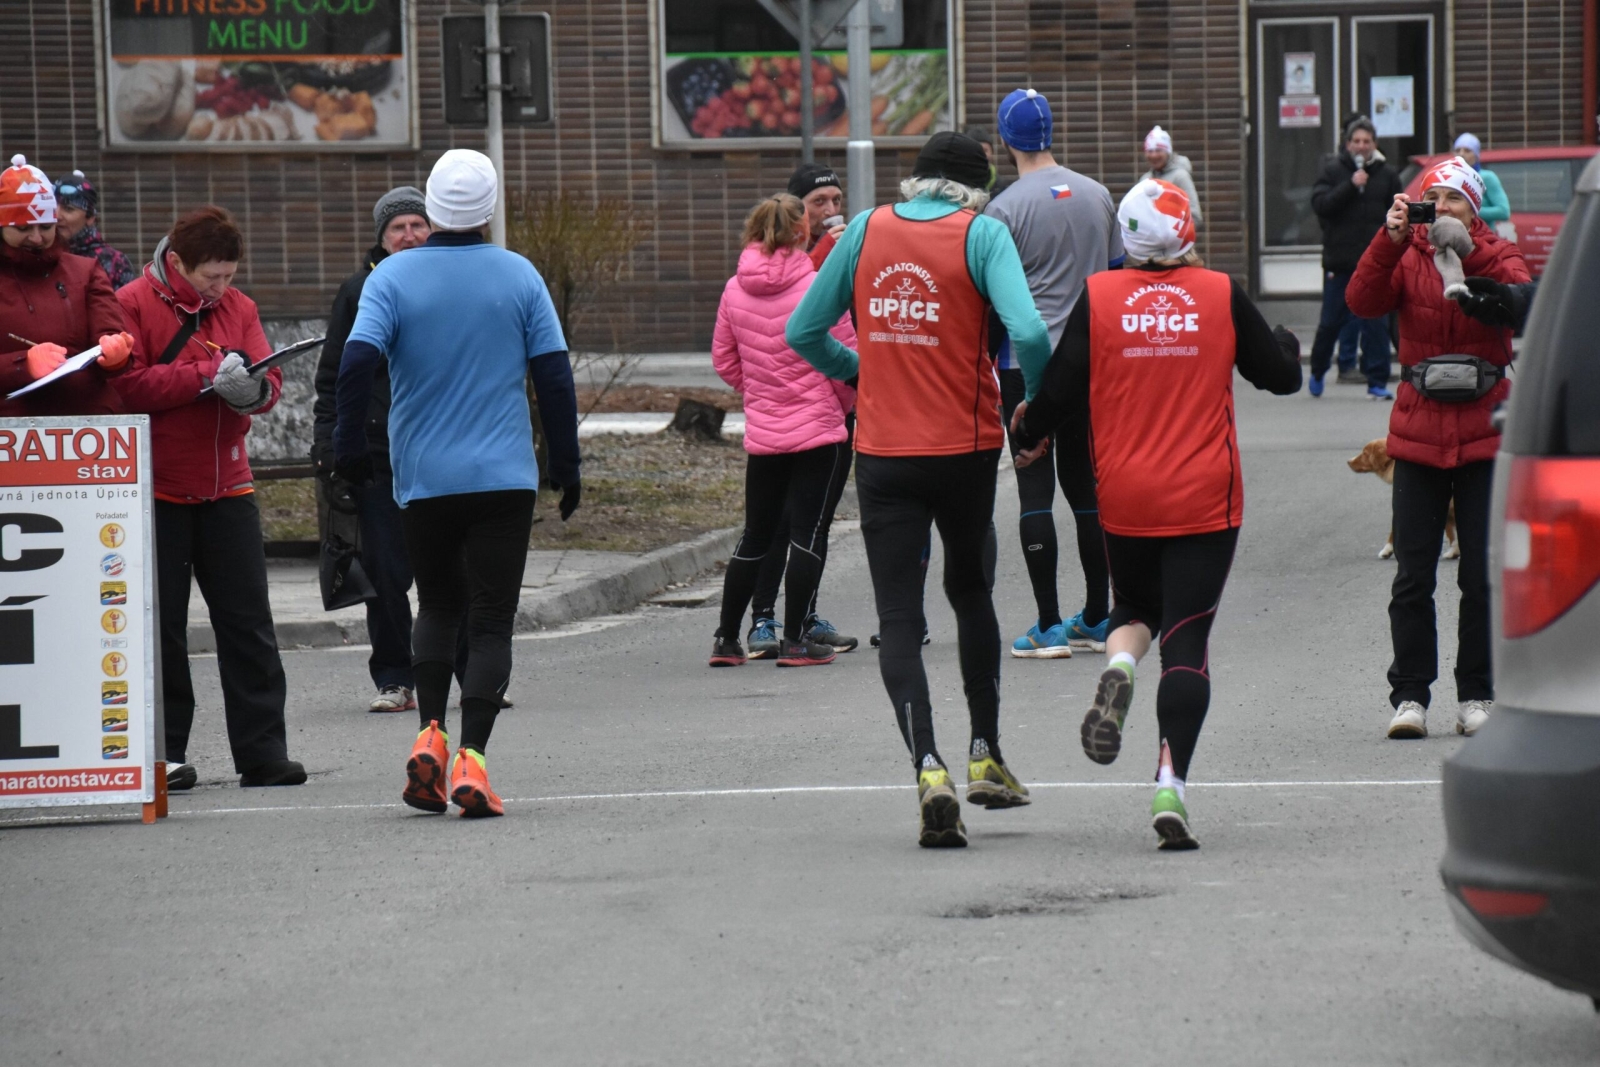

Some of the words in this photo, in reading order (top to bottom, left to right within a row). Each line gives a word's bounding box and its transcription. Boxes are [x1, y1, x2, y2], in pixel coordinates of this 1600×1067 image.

[207, 19, 309, 51] MENU
[872, 262, 939, 293] MARATONSTAV
[1124, 283, 1196, 307] MARATONSTAV
[895, 333, 939, 346] REPUBLIC
[1122, 346, 1153, 358] CZECH
[1155, 345, 1199, 356] REPUBLIC
[77, 463, 131, 479] stav
[31, 489, 88, 503] jednota
[96, 487, 138, 500] Úpice
[95, 511, 129, 519] Pořadatel
